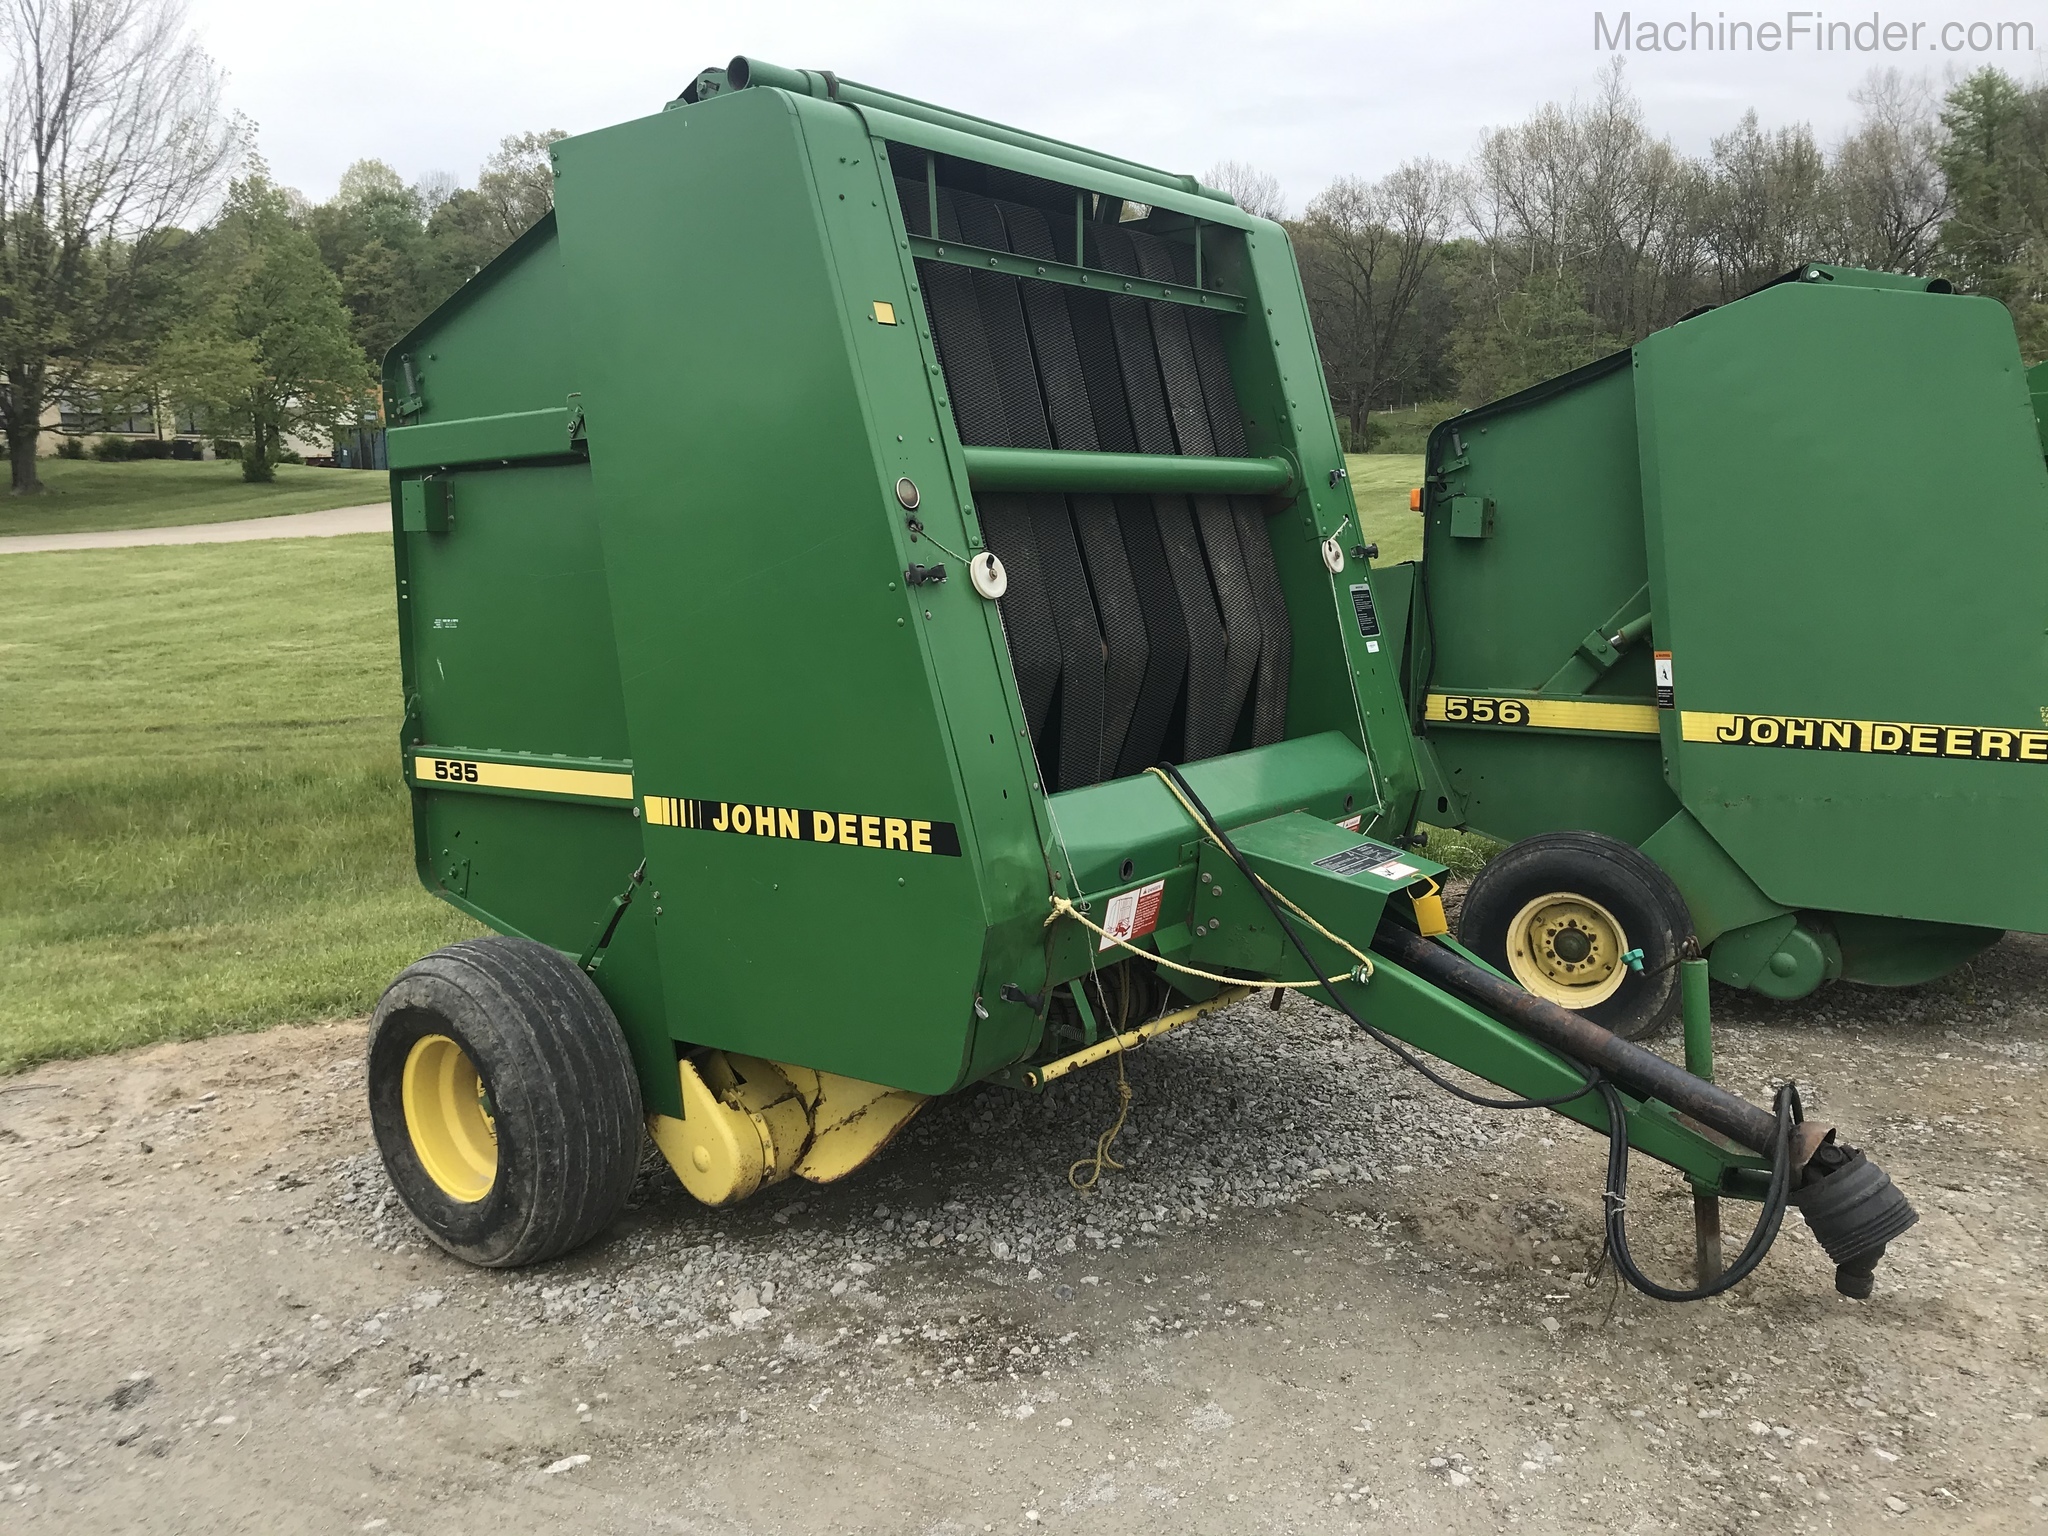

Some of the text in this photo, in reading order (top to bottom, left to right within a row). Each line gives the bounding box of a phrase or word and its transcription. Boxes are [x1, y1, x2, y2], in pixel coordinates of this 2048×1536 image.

[1444, 697, 1525, 725] 556
[1718, 716, 2048, 760] JOHN DEERE
[434, 760, 479, 783] 535
[712, 802, 933, 854] JOHN DEERE
